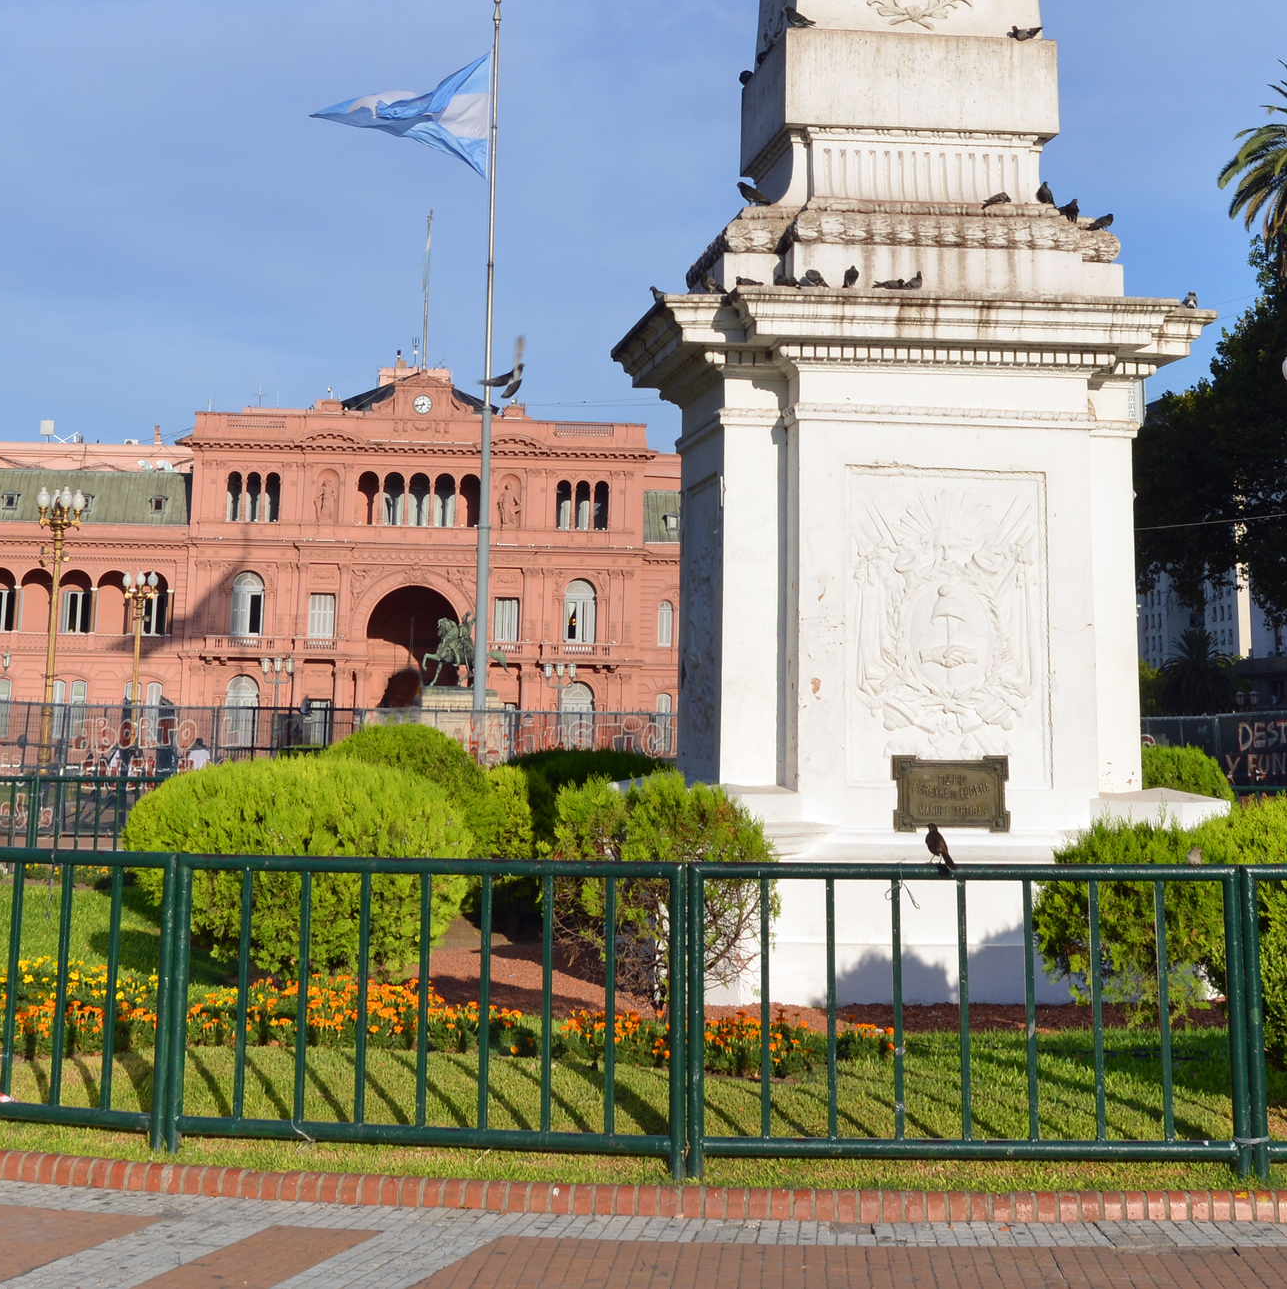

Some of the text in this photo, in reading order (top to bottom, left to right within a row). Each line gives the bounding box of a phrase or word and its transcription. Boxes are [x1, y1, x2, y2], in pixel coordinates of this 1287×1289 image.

[1225, 754, 1241, 783] Y
[917, 805, 987, 817] MANUEL ARTIGAS
